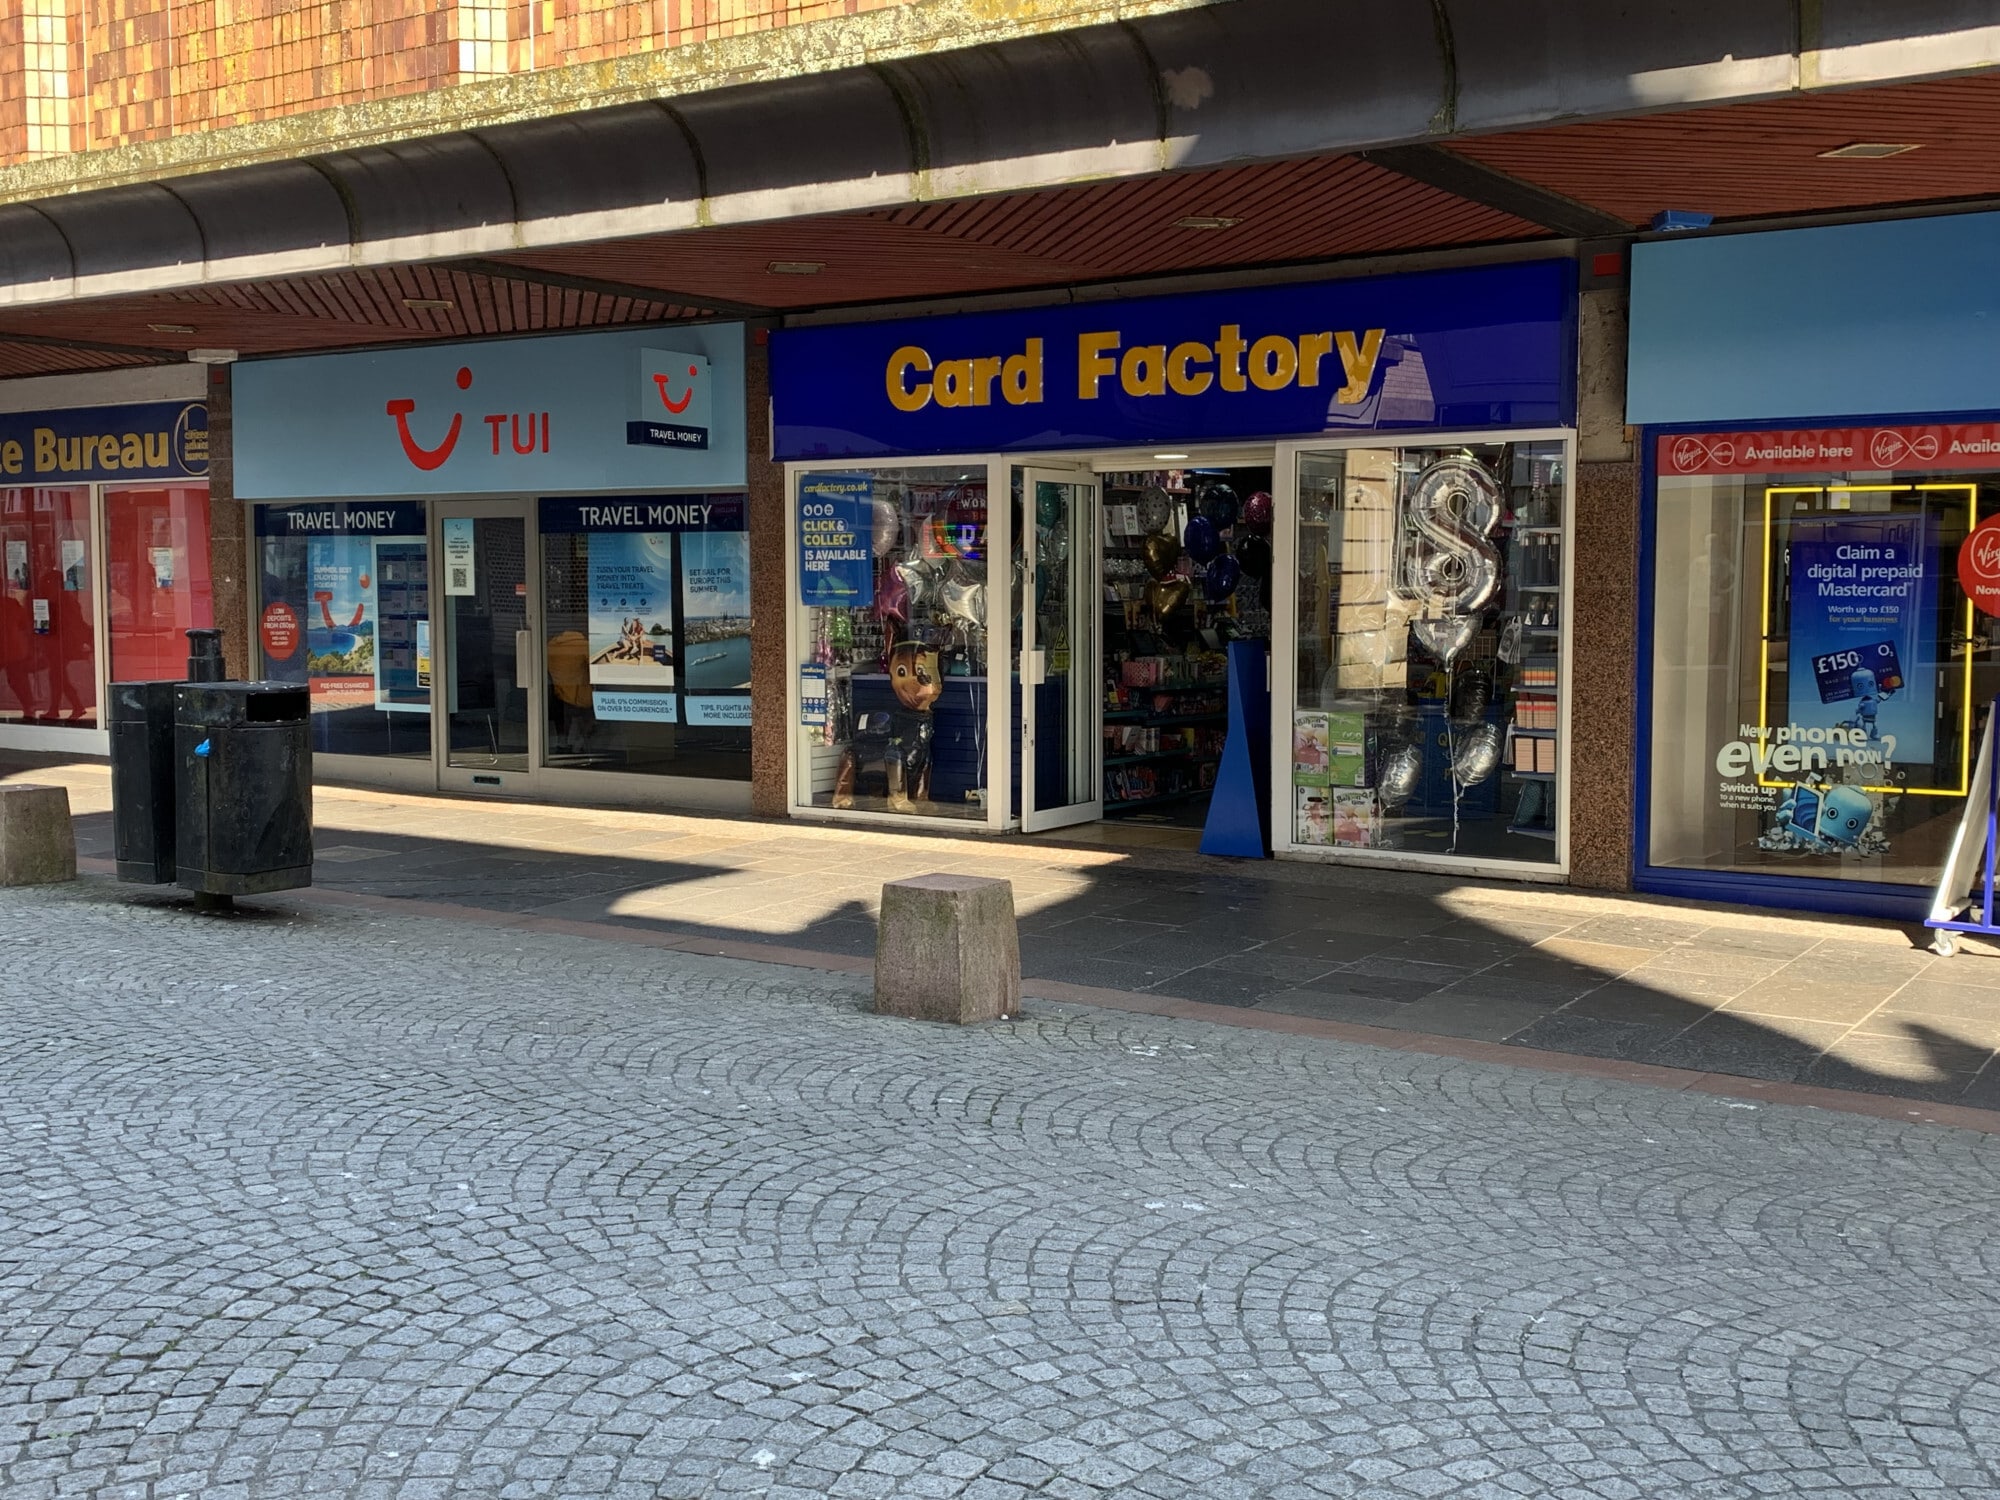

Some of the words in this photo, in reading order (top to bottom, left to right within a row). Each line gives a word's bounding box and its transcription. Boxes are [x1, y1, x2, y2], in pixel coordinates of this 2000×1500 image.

[884, 337, 1044, 412] Card
[1077, 324, 1387, 406] Factory
[484, 412, 549, 455] TUI
[649, 428, 677, 441] TRAVEL
[677, 431, 702, 443] MONEY
[0, 438, 23, 474] e
[34, 428, 169, 473] Bureau
[1677, 443, 1703, 466] Virgin
[1745, 445, 1815, 460] Available
[1818, 443, 1853, 458] here
[1874, 437, 1902, 462] Virgin
[803, 481, 868, 495] cardfactory.co.uk
[287, 511, 340, 530] TRAVEL
[343, 510, 396, 529] MONEY
[579, 506, 644, 526] TRAVEL
[648, 504, 712, 525] MONEY
[803, 520, 836, 532] CLICK
[836, 520, 845, 532] &
[803, 534, 854, 546] COLLECT
[804, 550, 815, 560] IS
[815, 549, 867, 560] AVAILABLE
[1836, 545, 1880, 560] Claim
[1884, 547, 1895, 560] a
[614, 566, 631, 574] YOUR
[717, 568, 731, 576] FOR
[804, 560, 830, 572] HERE
[1807, 563, 1857, 582] digital
[1861, 563, 1923, 582] prepaid
[597, 574, 620, 582] MONEY
[620, 574, 636, 582] INTO
[689, 577, 715, 585] EUROPE
[716, 576, 732, 584] THIS
[690, 586, 718, 594] SUMMER
[1828, 605, 1853, 613] Worth
[1856, 607, 1867, 615] up
[1869, 606, 1879, 614] to
[1880, 605, 1899, 614] £150
[1842, 617, 1861, 625] your
[1863, 615, 1898, 623] business
[1817, 651, 1860, 674] £150
[618, 698, 628, 706] 0%
[628, 698, 668, 706] COMMISSION
[716, 704, 742, 712] FLIGHTS
[1739, 724, 1772, 738] New
[1776, 723, 1868, 748] phone
[1716, 740, 1828, 778] even
[1719, 782, 1758, 794] Switch
[1760, 786, 1777, 796] up
[1719, 793, 1728, 801] to
[1719, 801, 1739, 809] when
[1746, 803, 1762, 811] suits
